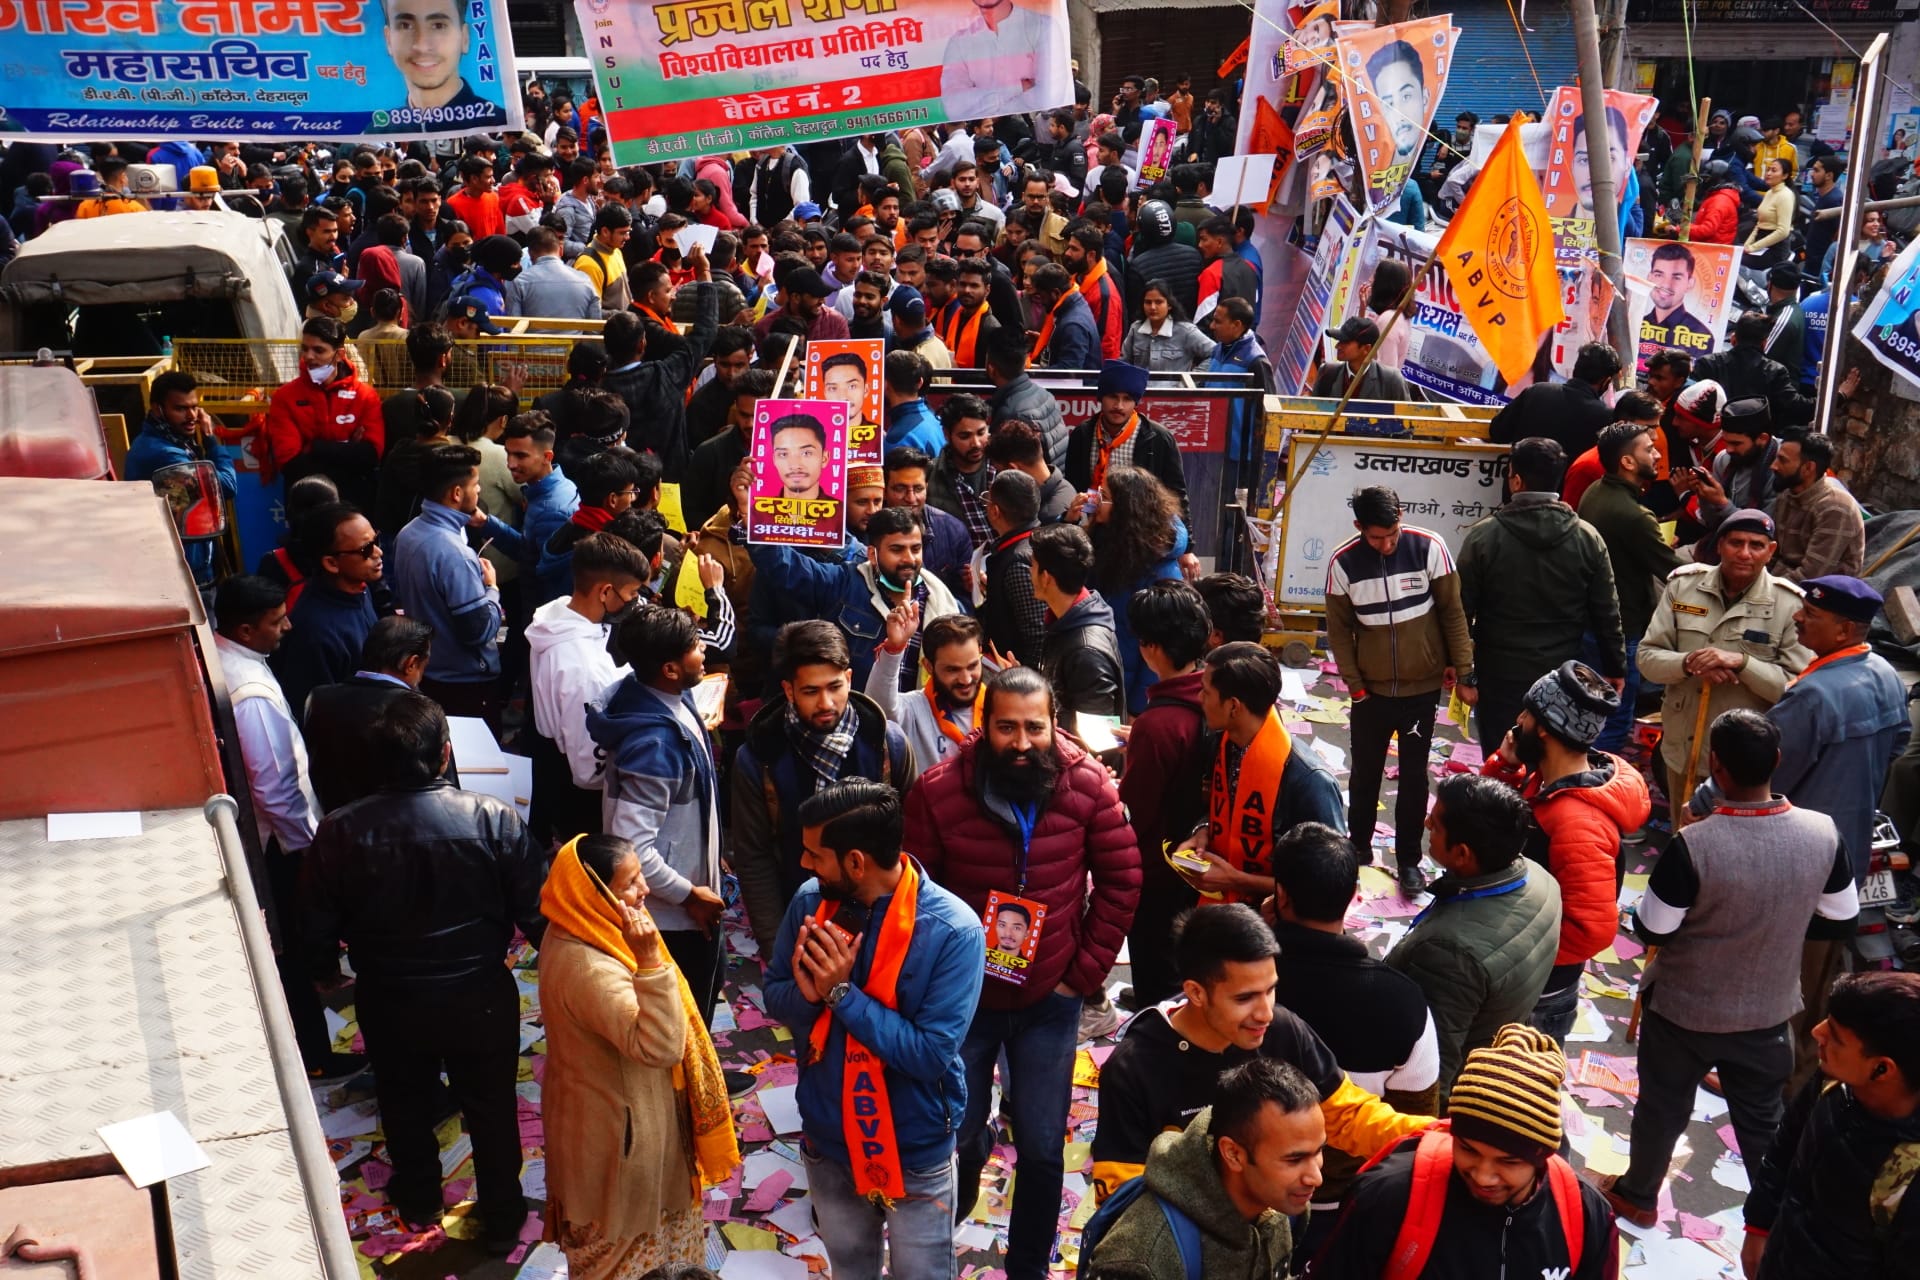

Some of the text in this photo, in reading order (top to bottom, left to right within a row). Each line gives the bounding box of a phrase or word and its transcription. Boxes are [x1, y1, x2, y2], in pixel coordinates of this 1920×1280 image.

[657, 17, 923, 80] विश्वविद्यालय प्रतिनिधि
[860, 50, 909, 69] पद हेतु
[62, 39, 366, 85] महासचिव पद हेतु
[255, 90, 308, 105] देहरादून
[719, 94, 790, 120] बैलेट
[842, 86, 863, 106] 2
[48, 112, 342, 132] Relationship Built on Trust
[391, 102, 496, 124] 8954903822
[846, 107, 929, 129] 9411566171
[1354, 452, 1474, 478] उत्तराखण्ड
[753, 496, 839, 518] दयाल
[1452, 500, 1484, 518] बेटी
[754, 524, 814, 537] अध्यक्ष
[853, 1071, 885, 1160] ABVP
